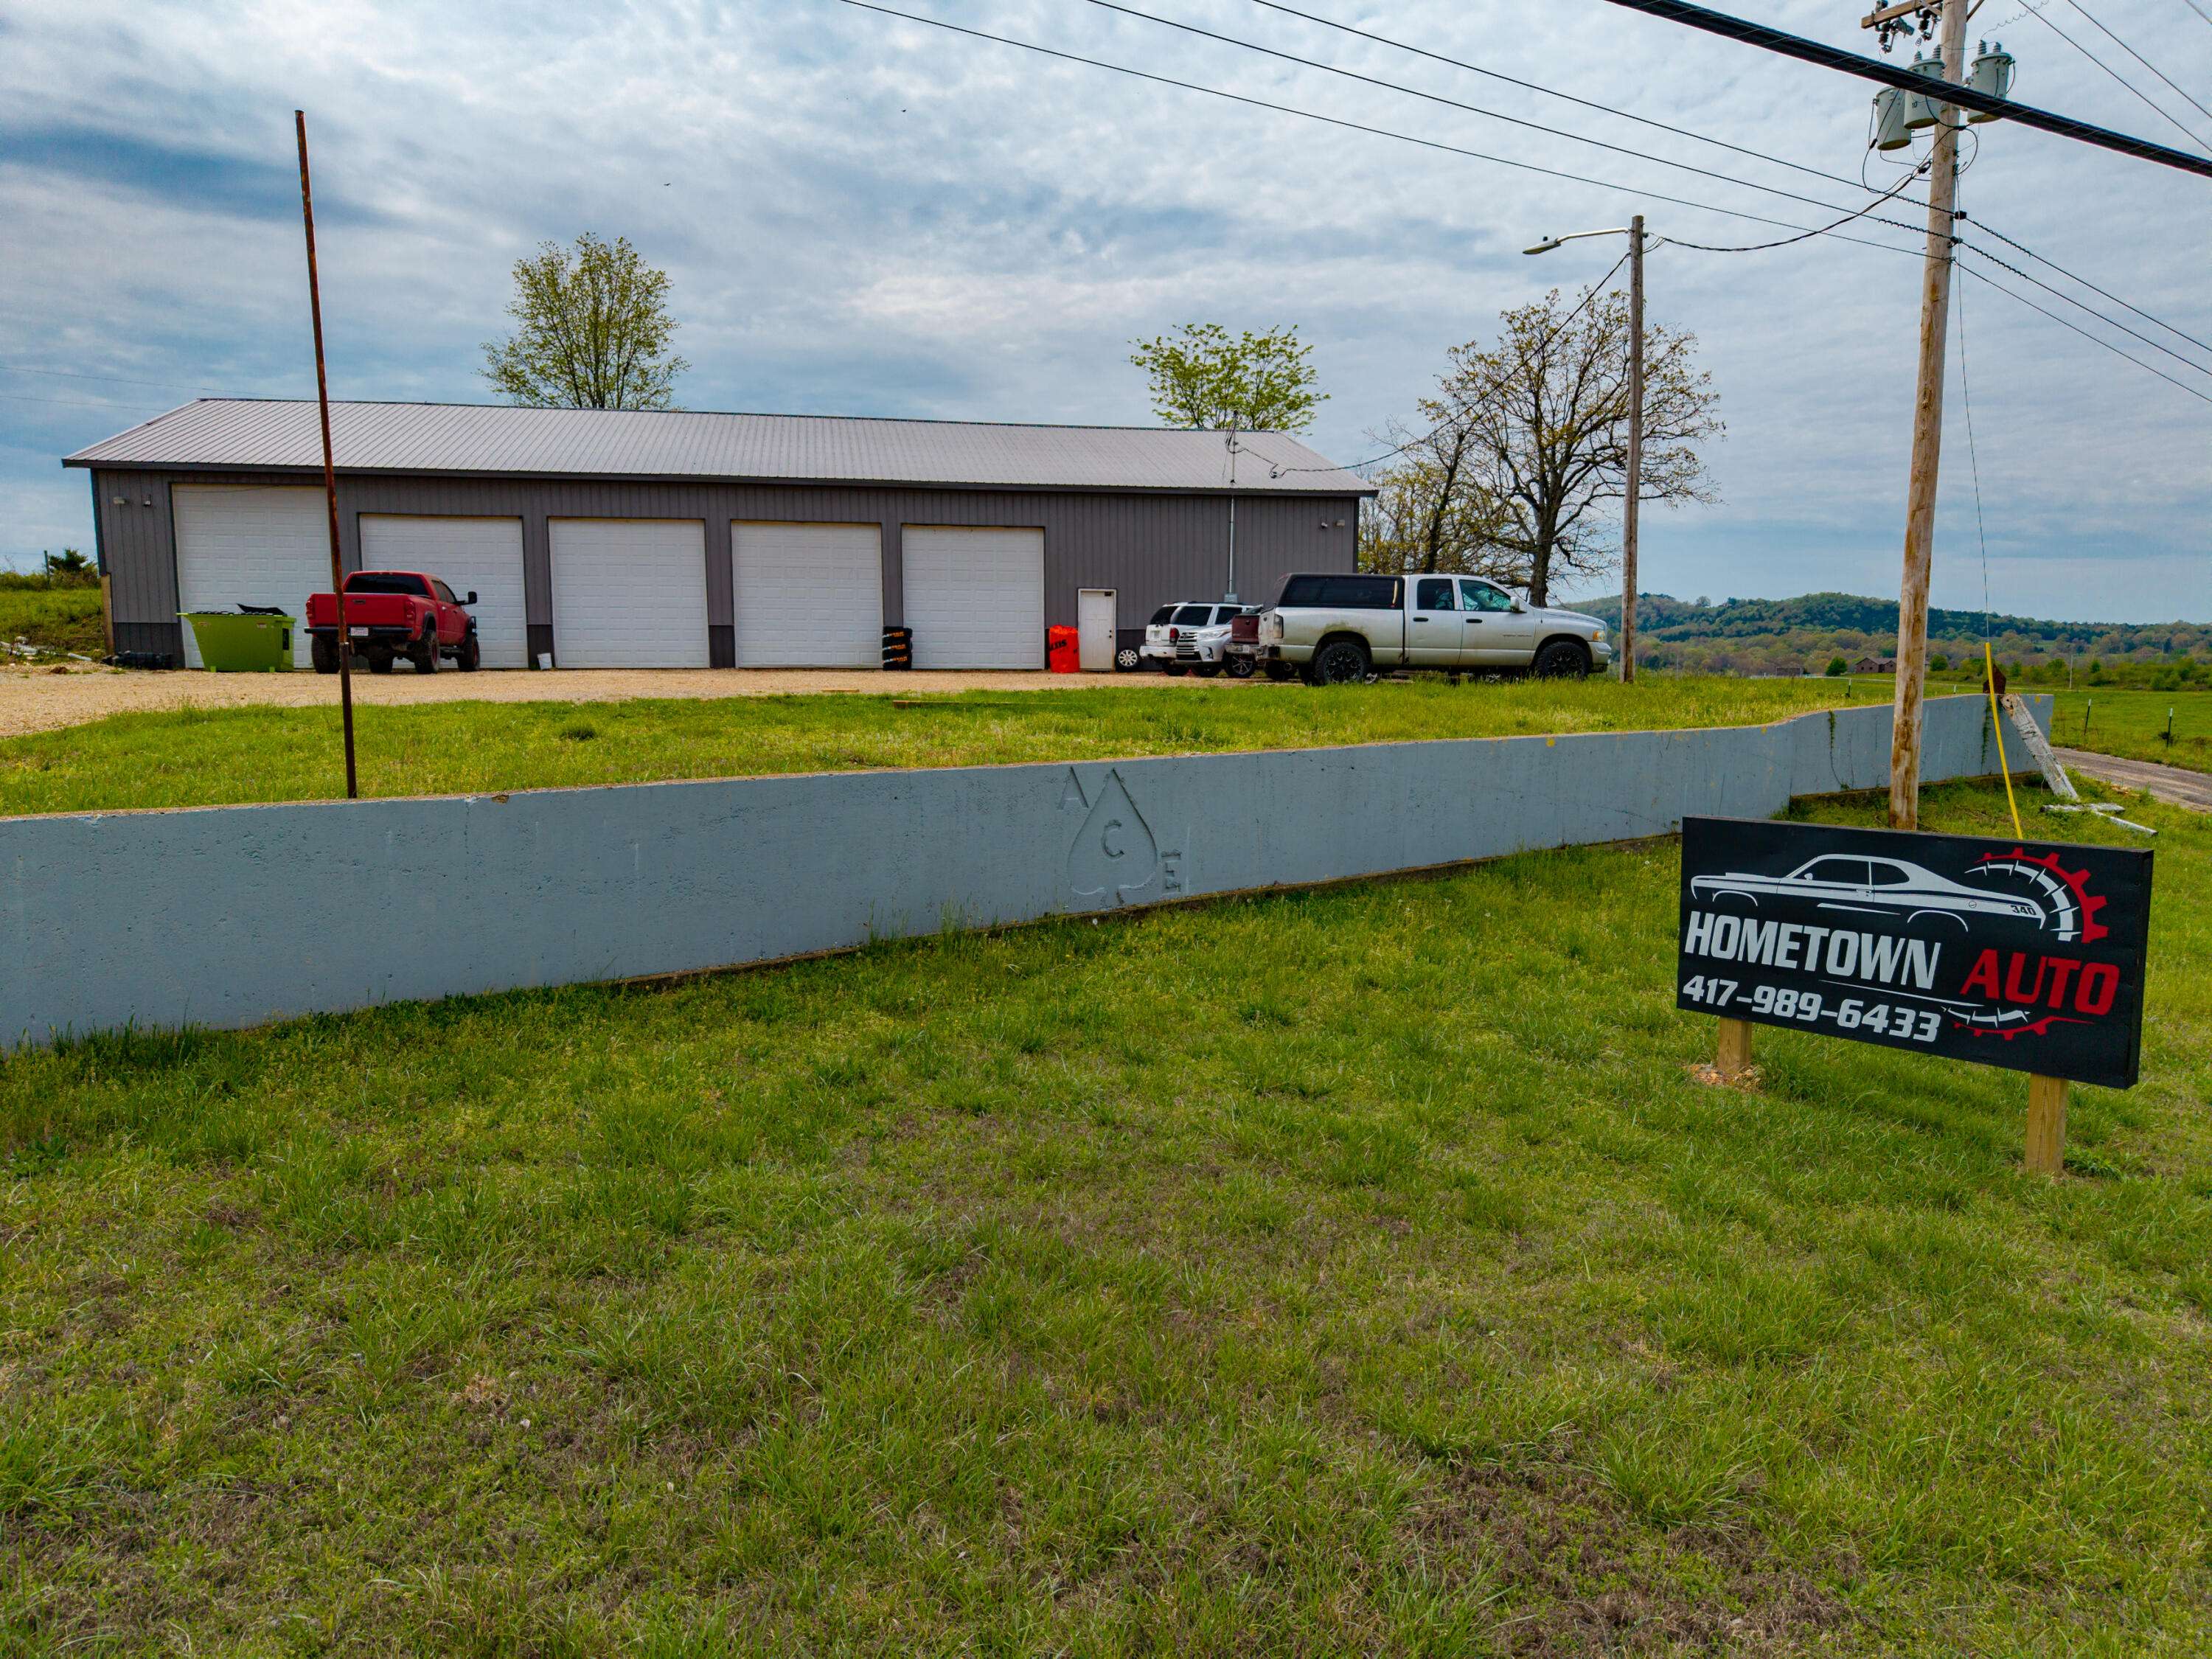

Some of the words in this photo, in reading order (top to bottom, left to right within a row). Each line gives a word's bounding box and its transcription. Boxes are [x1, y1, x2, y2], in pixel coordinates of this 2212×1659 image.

[2011, 905, 2037, 916] 340
[1685, 911, 1941, 990] HOMETOWN
[1961, 949, 2120, 1015] AUTO
[1683, 975, 1941, 1042] 417-989-6433
